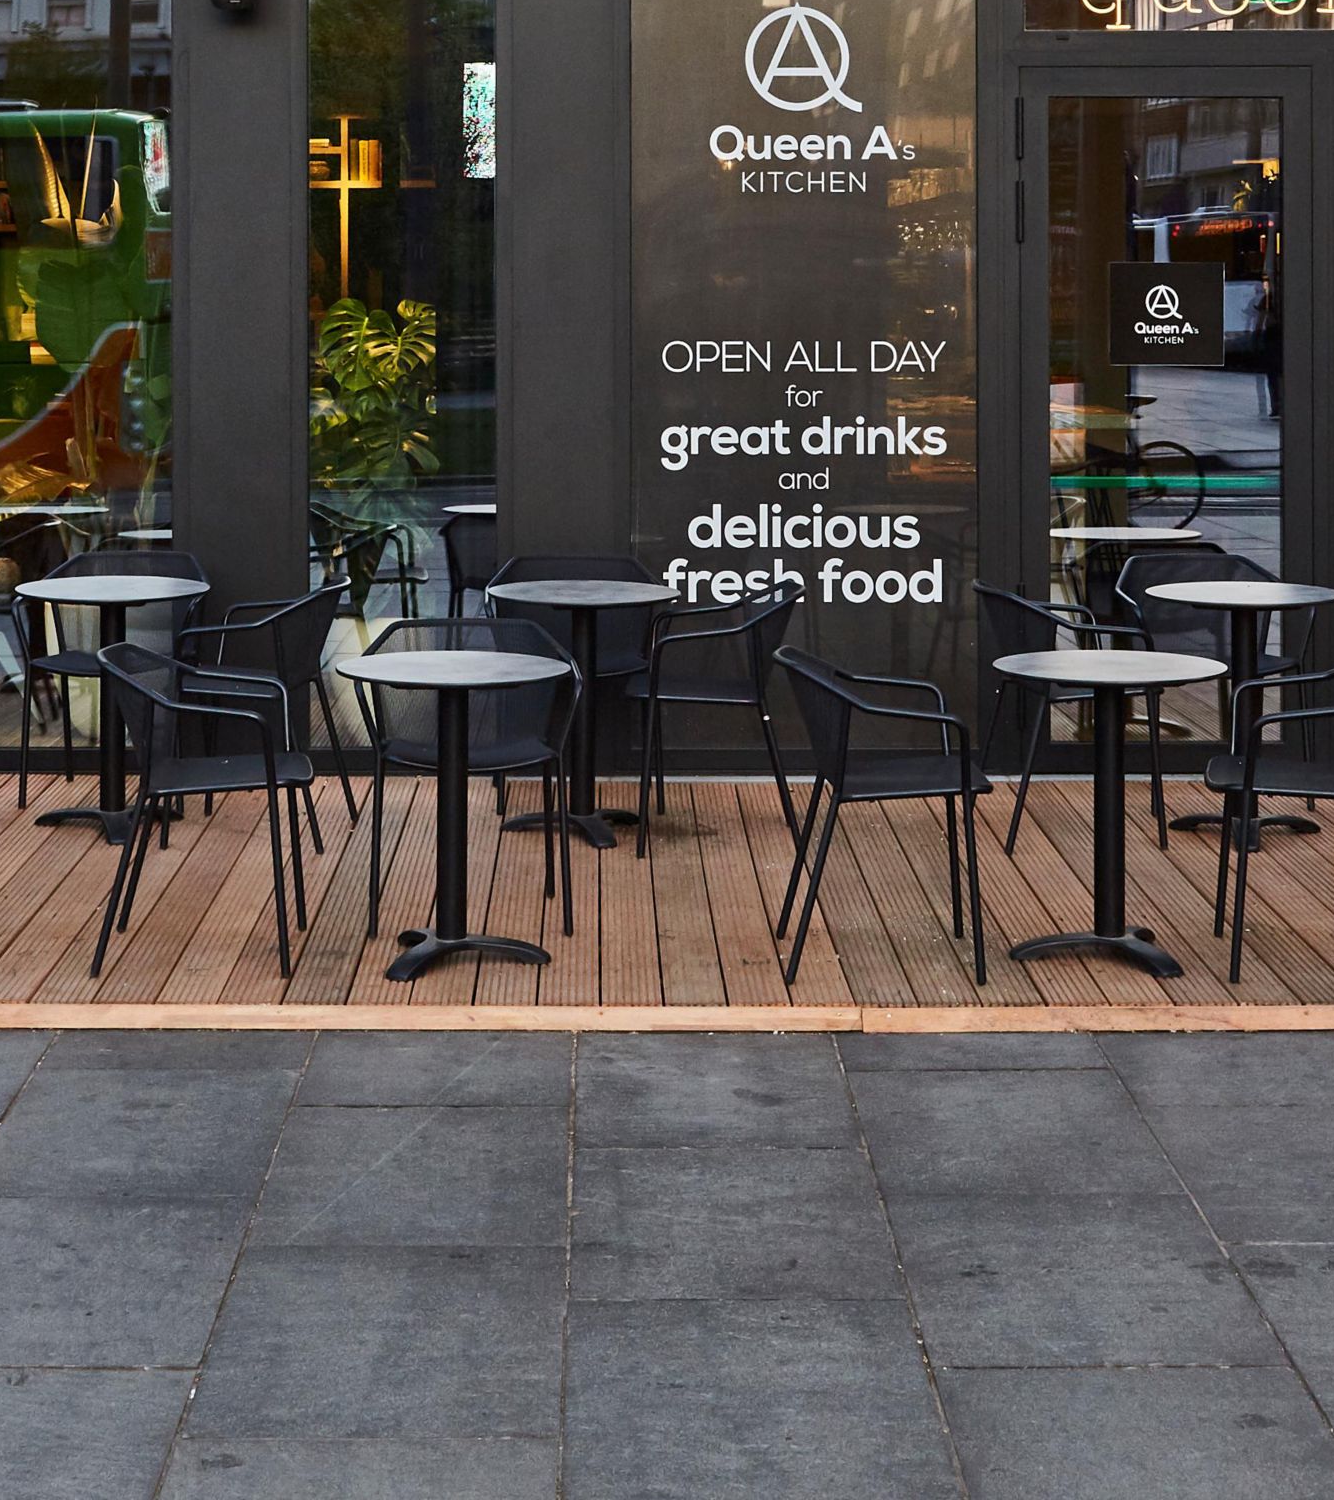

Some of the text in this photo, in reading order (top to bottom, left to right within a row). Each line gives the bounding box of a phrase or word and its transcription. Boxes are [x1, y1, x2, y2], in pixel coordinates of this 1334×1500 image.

[709, 124, 916, 163] Queen A's
[741, 171, 867, 193] KITCHEN
[1134, 321, 1180, 334] Queen
[1144, 336, 1185, 345] KITCHEN
[661, 340, 947, 373] OPEN ALL DAY
[784, 384, 824, 407] for
[660, 415, 947, 471] great drinks
[778, 467, 830, 490] and
[687, 503, 921, 549] delicious
[662, 557, 944, 604] fresh food
